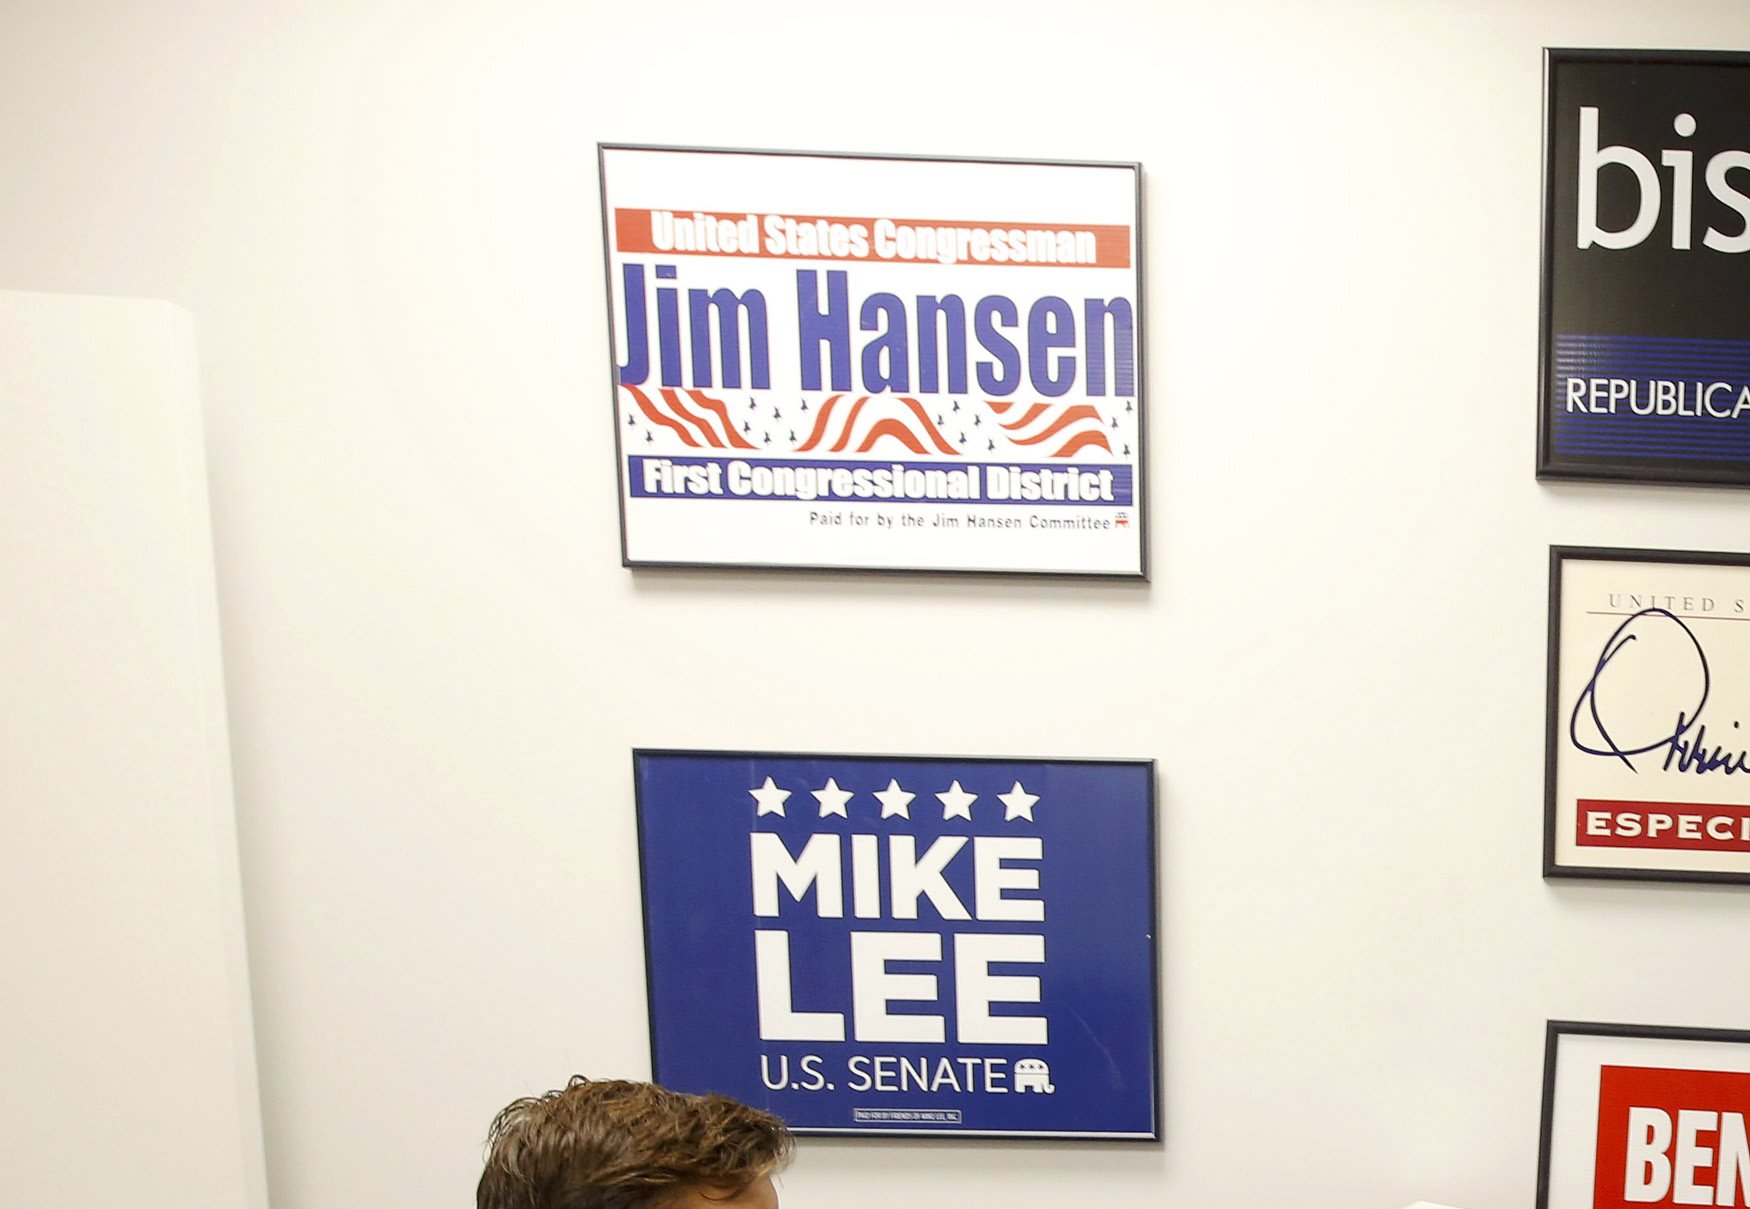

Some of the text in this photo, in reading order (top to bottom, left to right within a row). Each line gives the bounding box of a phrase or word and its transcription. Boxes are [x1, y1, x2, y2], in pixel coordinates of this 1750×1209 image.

[650, 210, 1097, 265] United States Congressman
[616, 263, 1135, 397] Jim Hansen
[642, 459, 1115, 502] First Congressional District
[809, 511, 1111, 531] Paid for by the Jim Hansen Committee
[1608, 593, 1716, 612] UNITED
[749, 832, 1046, 921] MIKE
[753, 929, 1049, 1045] LEE
[760, 1054, 1009, 1094] U.S. SENATE
